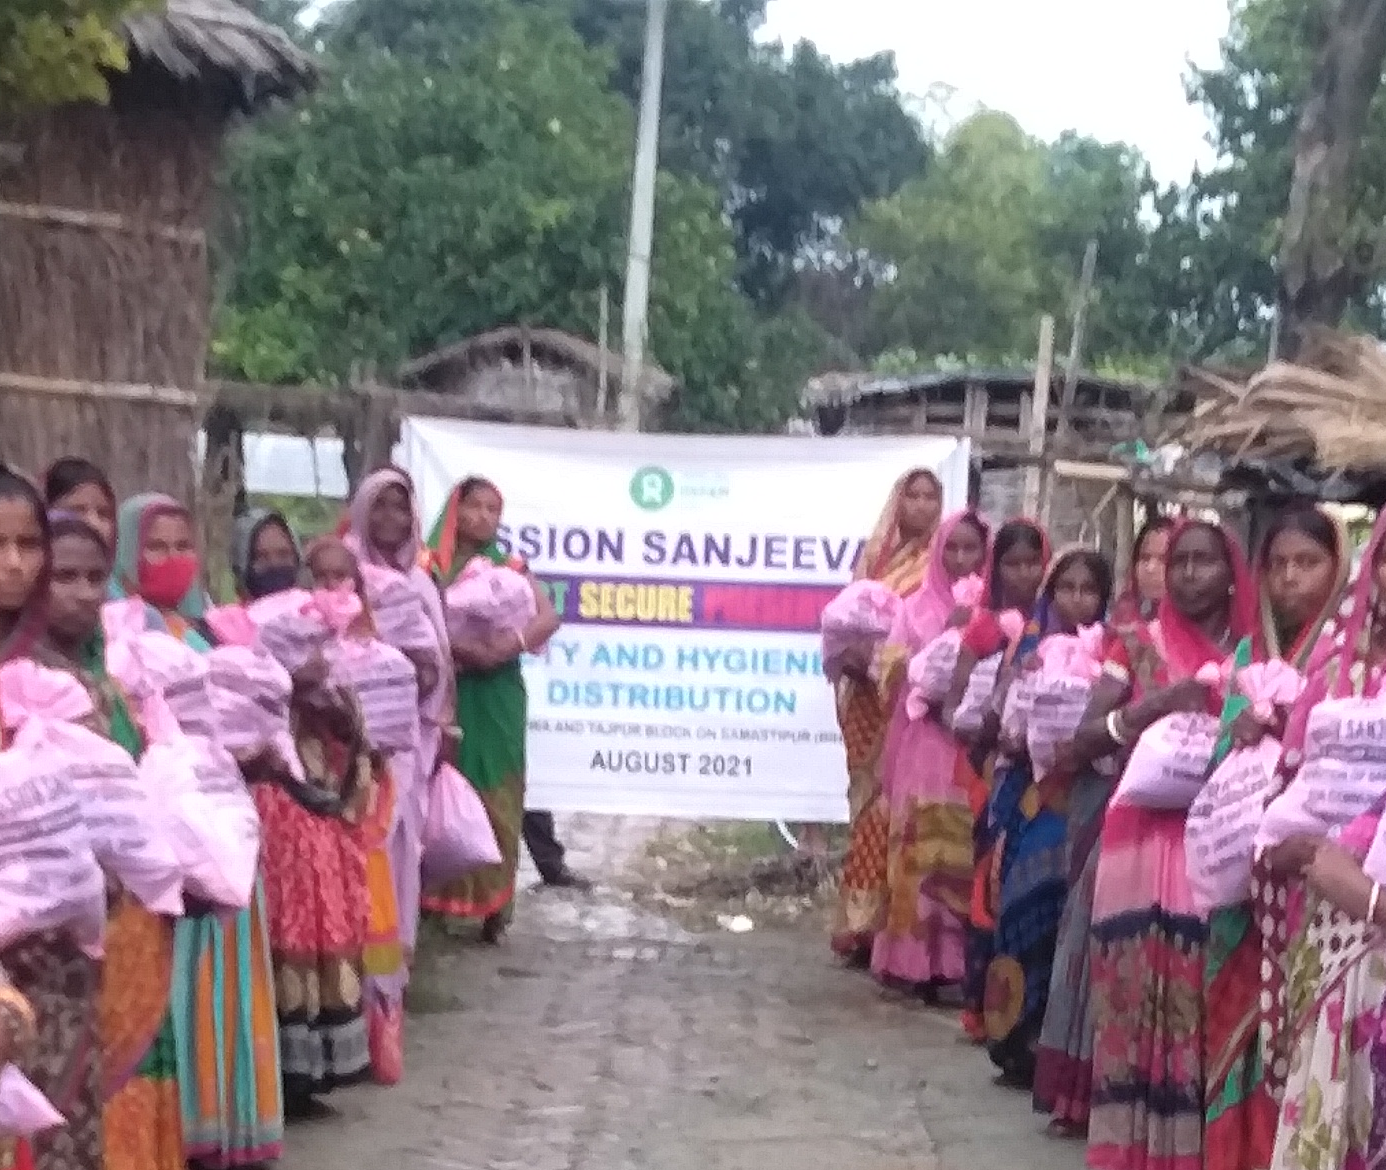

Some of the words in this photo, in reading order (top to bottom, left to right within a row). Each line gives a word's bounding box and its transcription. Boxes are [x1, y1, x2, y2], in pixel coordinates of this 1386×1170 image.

[579, 580, 694, 623] SECURE
[591, 641, 665, 670] AND
[548, 680, 797, 714] DISTRIBUTION
[590, 750, 691, 774] AUGUST
[699, 754, 752, 778] 2021
